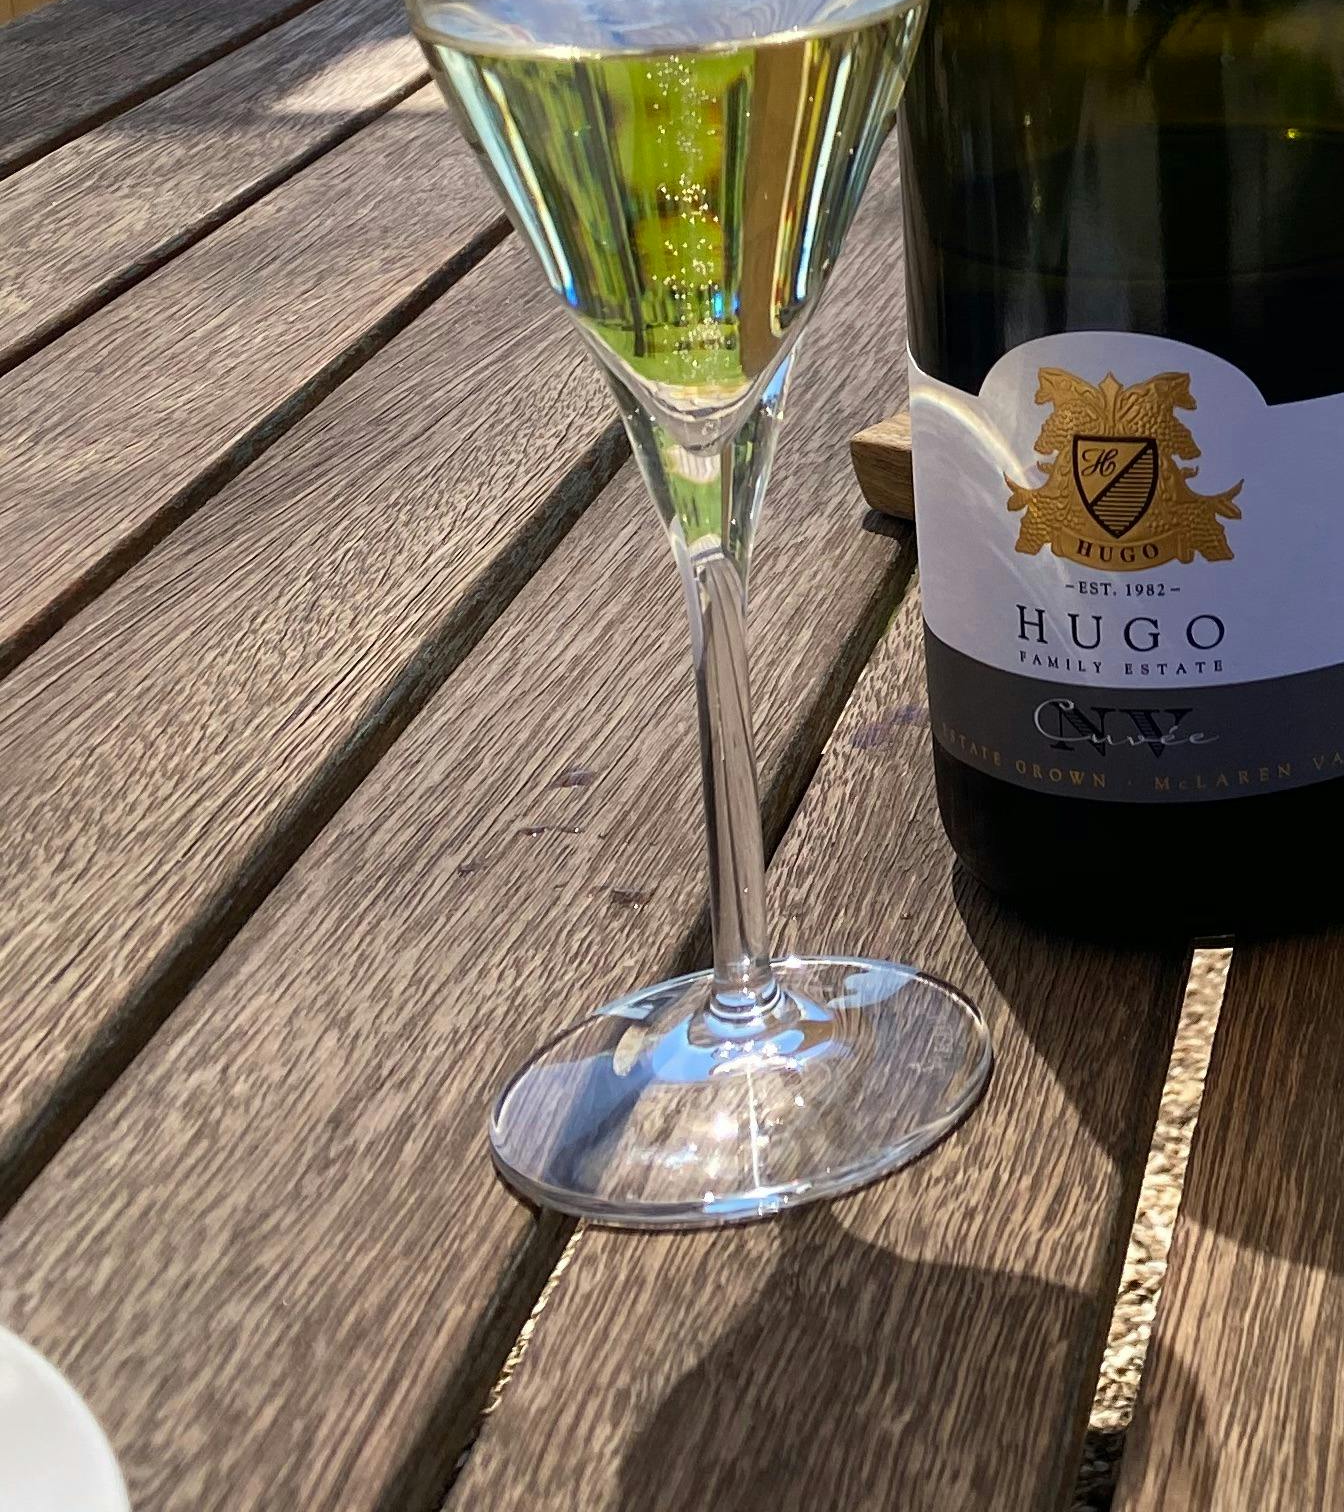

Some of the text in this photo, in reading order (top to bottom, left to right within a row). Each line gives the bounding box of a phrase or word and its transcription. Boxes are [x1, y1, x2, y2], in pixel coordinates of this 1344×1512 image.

[1077, 538, 1159, 563] HUGO
[1015, 604, 1225, 652] HUGO
[1019, 650, 1223, 675] FAMILY ESTATE
